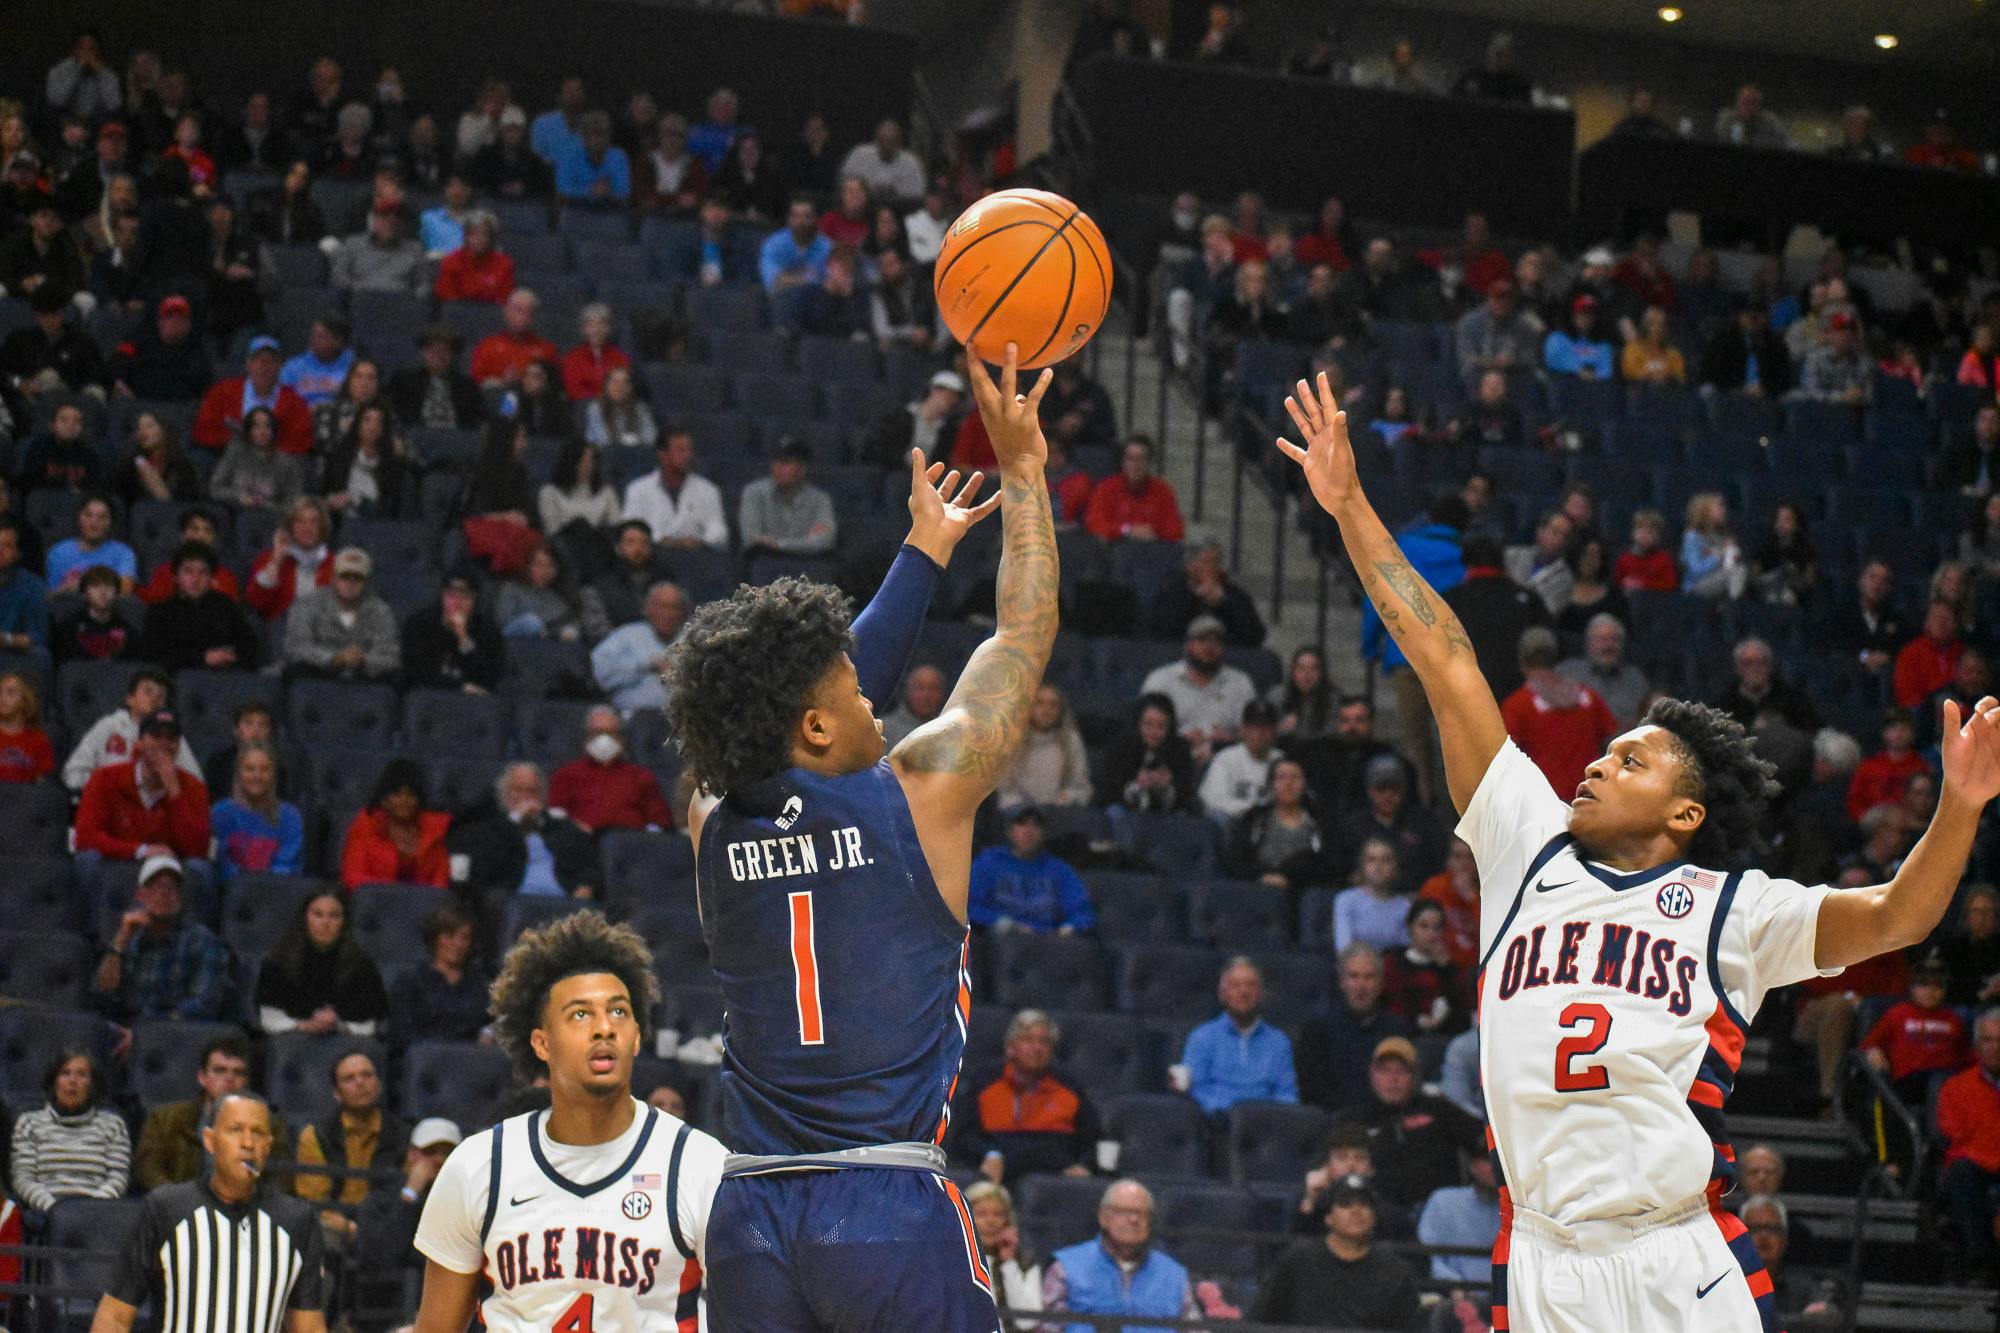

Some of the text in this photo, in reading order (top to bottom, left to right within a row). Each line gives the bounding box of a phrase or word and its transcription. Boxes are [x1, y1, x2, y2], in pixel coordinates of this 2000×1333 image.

[727, 826, 874, 881] GREEN JR.
[1658, 884, 1693, 918] SEC
[788, 891, 825, 1045] 1
[1499, 921, 1698, 1017] OLE MISS
[1554, 1002, 1613, 1093] 2
[622, 1191, 651, 1219] SEC
[497, 1227, 662, 1295] OLE MISS
